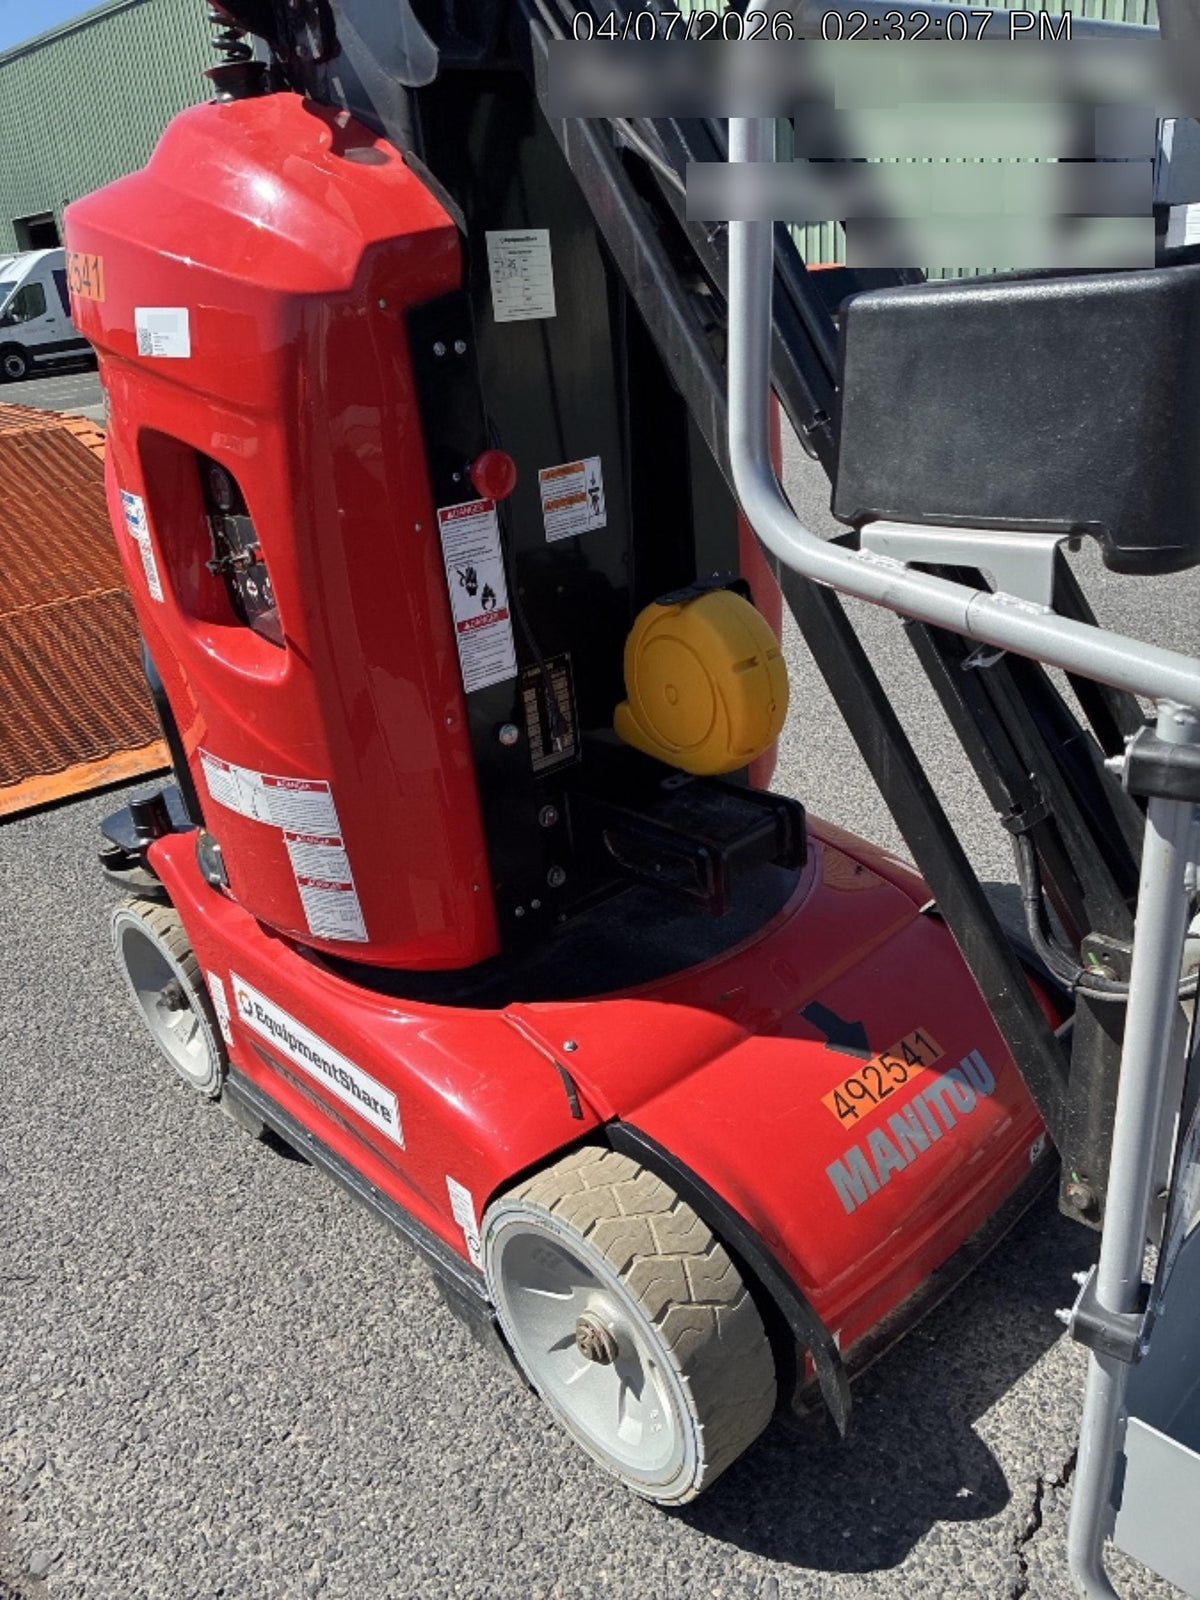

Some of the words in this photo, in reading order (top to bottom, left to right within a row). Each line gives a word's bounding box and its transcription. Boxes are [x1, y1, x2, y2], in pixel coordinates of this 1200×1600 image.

[70, 253, 100, 298] 541
[252, 1001, 392, 1125] EquipmentShare
[832, 1030, 940, 1120] 492541
[824, 1048, 996, 1216] MANITOU
